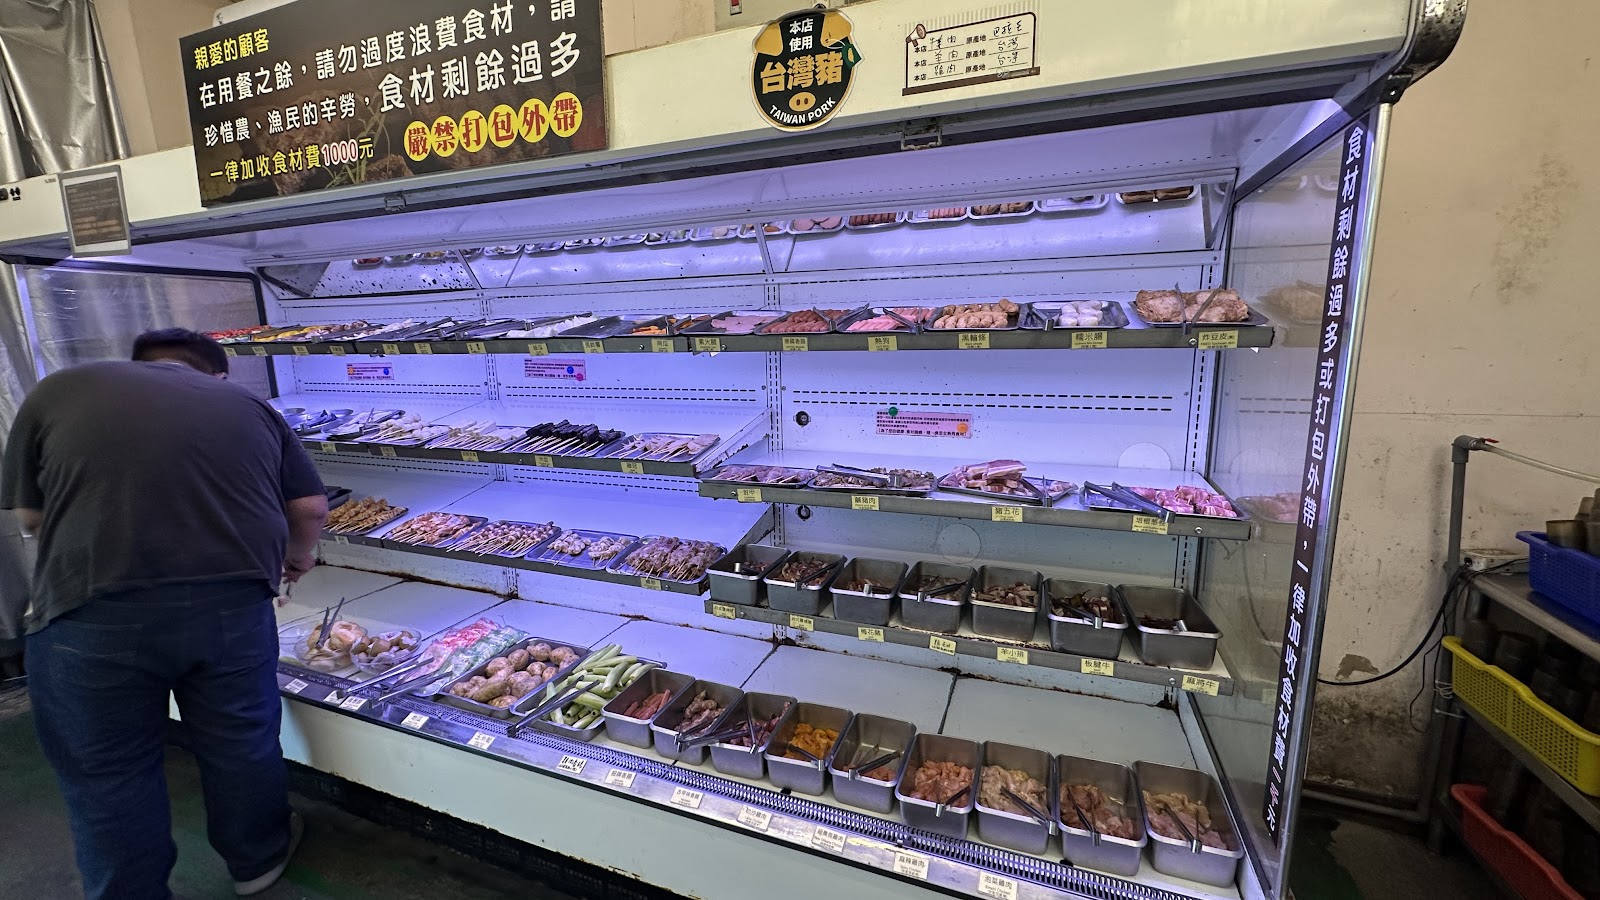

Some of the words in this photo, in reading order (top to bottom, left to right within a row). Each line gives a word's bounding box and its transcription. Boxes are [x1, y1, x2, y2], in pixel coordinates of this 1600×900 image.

[789, 18, 814, 34] 本店
[194, 28, 270, 71] 親愛的顧客
[789, 36, 813, 52] 使用
[914, 45, 927, 53] 本店
[966, 34, 987, 44] 原產地
[914, 59, 927, 67] 本店
[965, 48, 986, 59] 原產地
[760, 50, 843, 94] 台灣豬
[914, 73, 927, 82] 本店
[965, 64, 986, 74] 原產地
[770, 104, 806, 125] TAIWAN
[807, 97, 836, 123] PORK
[407, 97, 581, 158] 嚴禁打包外帶
[210, 137, 375, 183] 一律加收食材費1000元
[984, 875, 1012, 889] 泡菜雞肉
